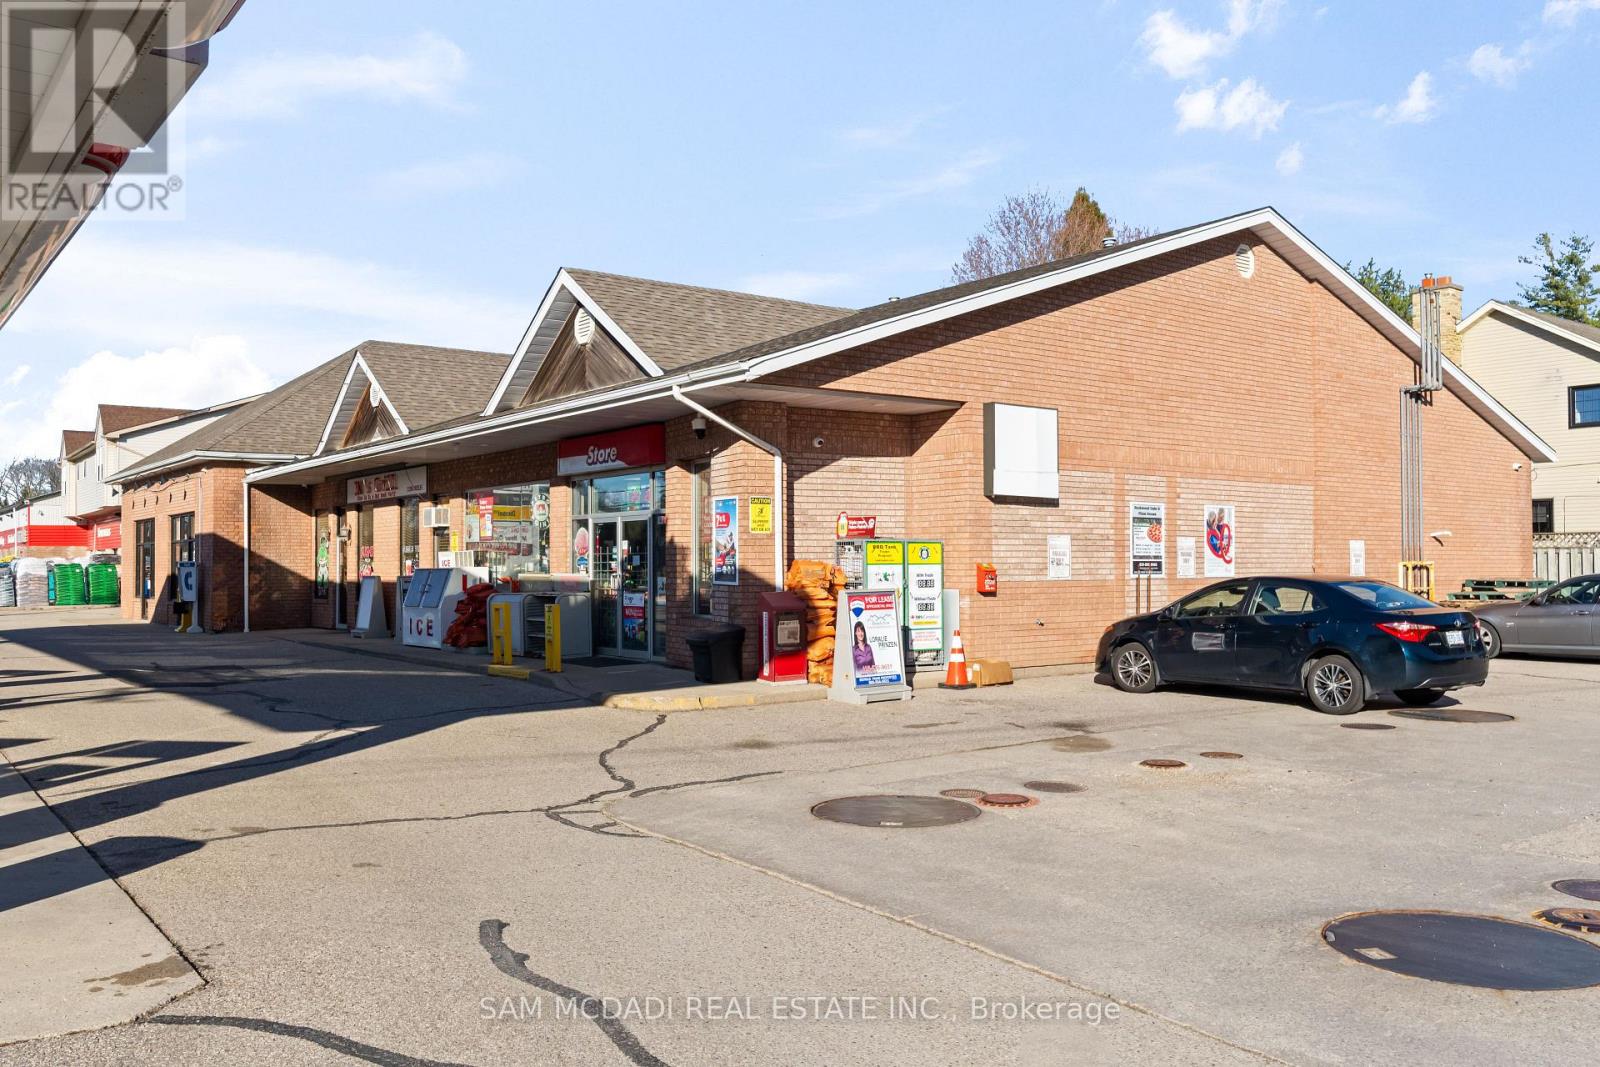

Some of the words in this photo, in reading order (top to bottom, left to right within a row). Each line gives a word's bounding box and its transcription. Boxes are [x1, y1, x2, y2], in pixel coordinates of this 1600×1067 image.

[587, 446, 617, 465] Store
[750, 497, 771, 505] CAUTION
[441, 559, 451, 567] ICE
[409, 617, 434, 637] ICE
